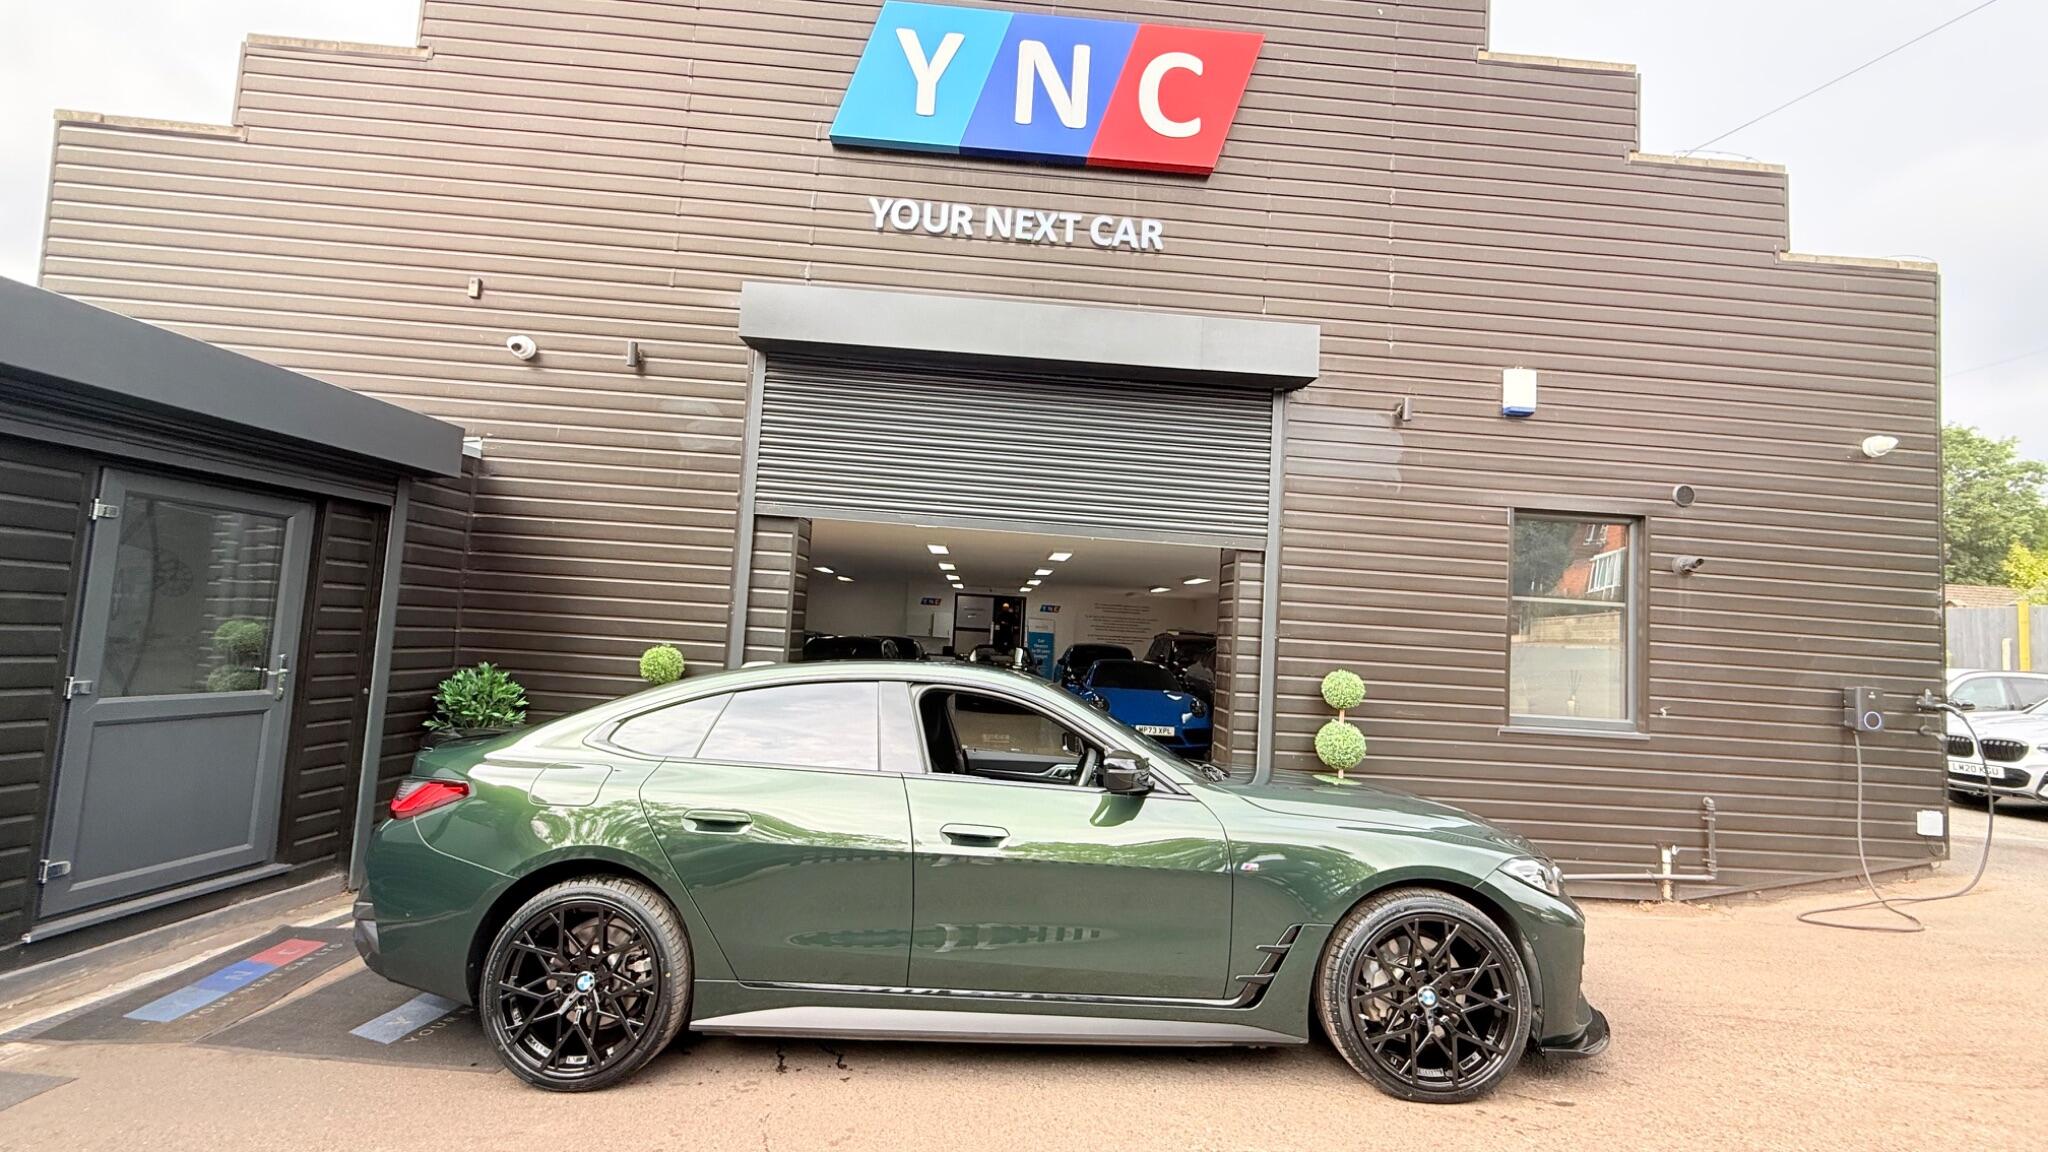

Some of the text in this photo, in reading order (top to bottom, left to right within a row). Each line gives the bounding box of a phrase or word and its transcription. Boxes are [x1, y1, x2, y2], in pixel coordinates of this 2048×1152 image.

[895, 28, 1204, 138] YNC
[868, 197, 1164, 250] YOUR NEXT CAR
